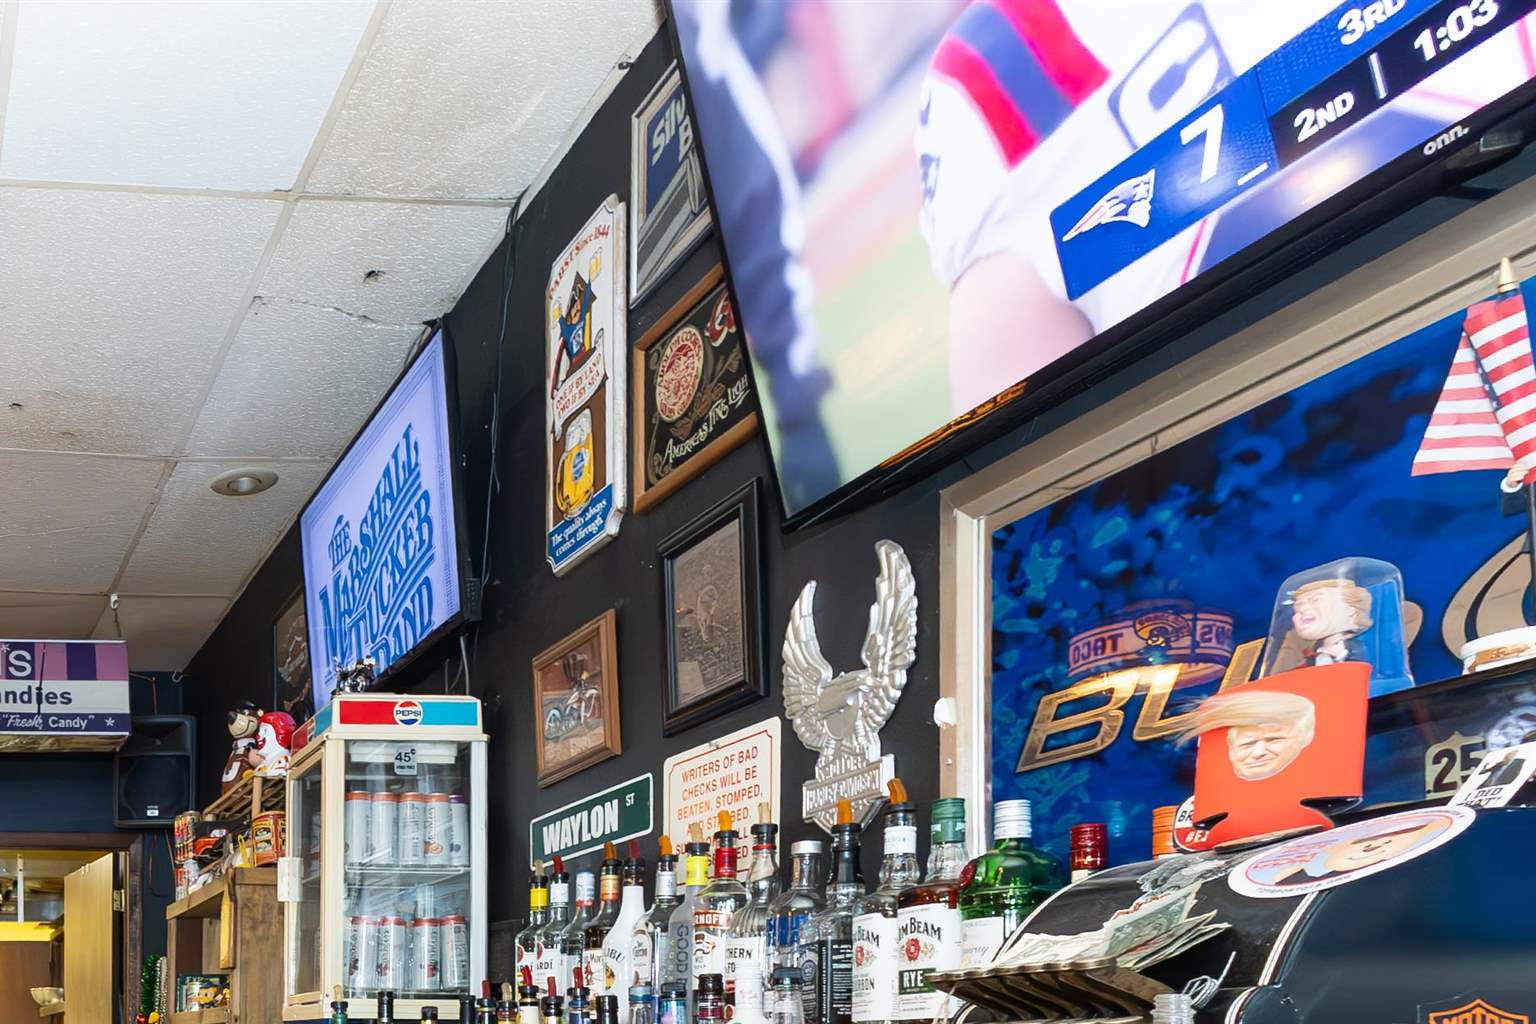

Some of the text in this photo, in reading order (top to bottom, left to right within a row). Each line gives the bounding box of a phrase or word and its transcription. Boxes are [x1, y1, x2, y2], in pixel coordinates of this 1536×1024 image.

[1337, 0, 1407, 46] 3RD
[1414, 0, 1500, 62] 1:03
[1293, 91, 1355, 143] 2ND
[1180, 103, 1224, 184] 7
[1423, 125, 1470, 156] onn.
[593, 223, 611, 242] 1844
[319, 422, 421, 669] MARSHALL
[329, 518, 352, 571] THE
[551, 532, 563, 548] The
[562, 513, 585, 539] quality
[555, 539, 575, 557] comes
[348, 488, 435, 661] TUCKER
[369, 575, 434, 678] BAND
[395, 708, 422, 718] PEPSI
[681, 746, 759, 783] WRITERS OF BAD
[682, 765, 758, 802] CHECKS WILL BE
[542, 792, 637, 856] WAYLON ST
[676, 923, 690, 974] GOOD
[909, 916, 942, 943] BEAM
[903, 970, 924, 988] RYE
